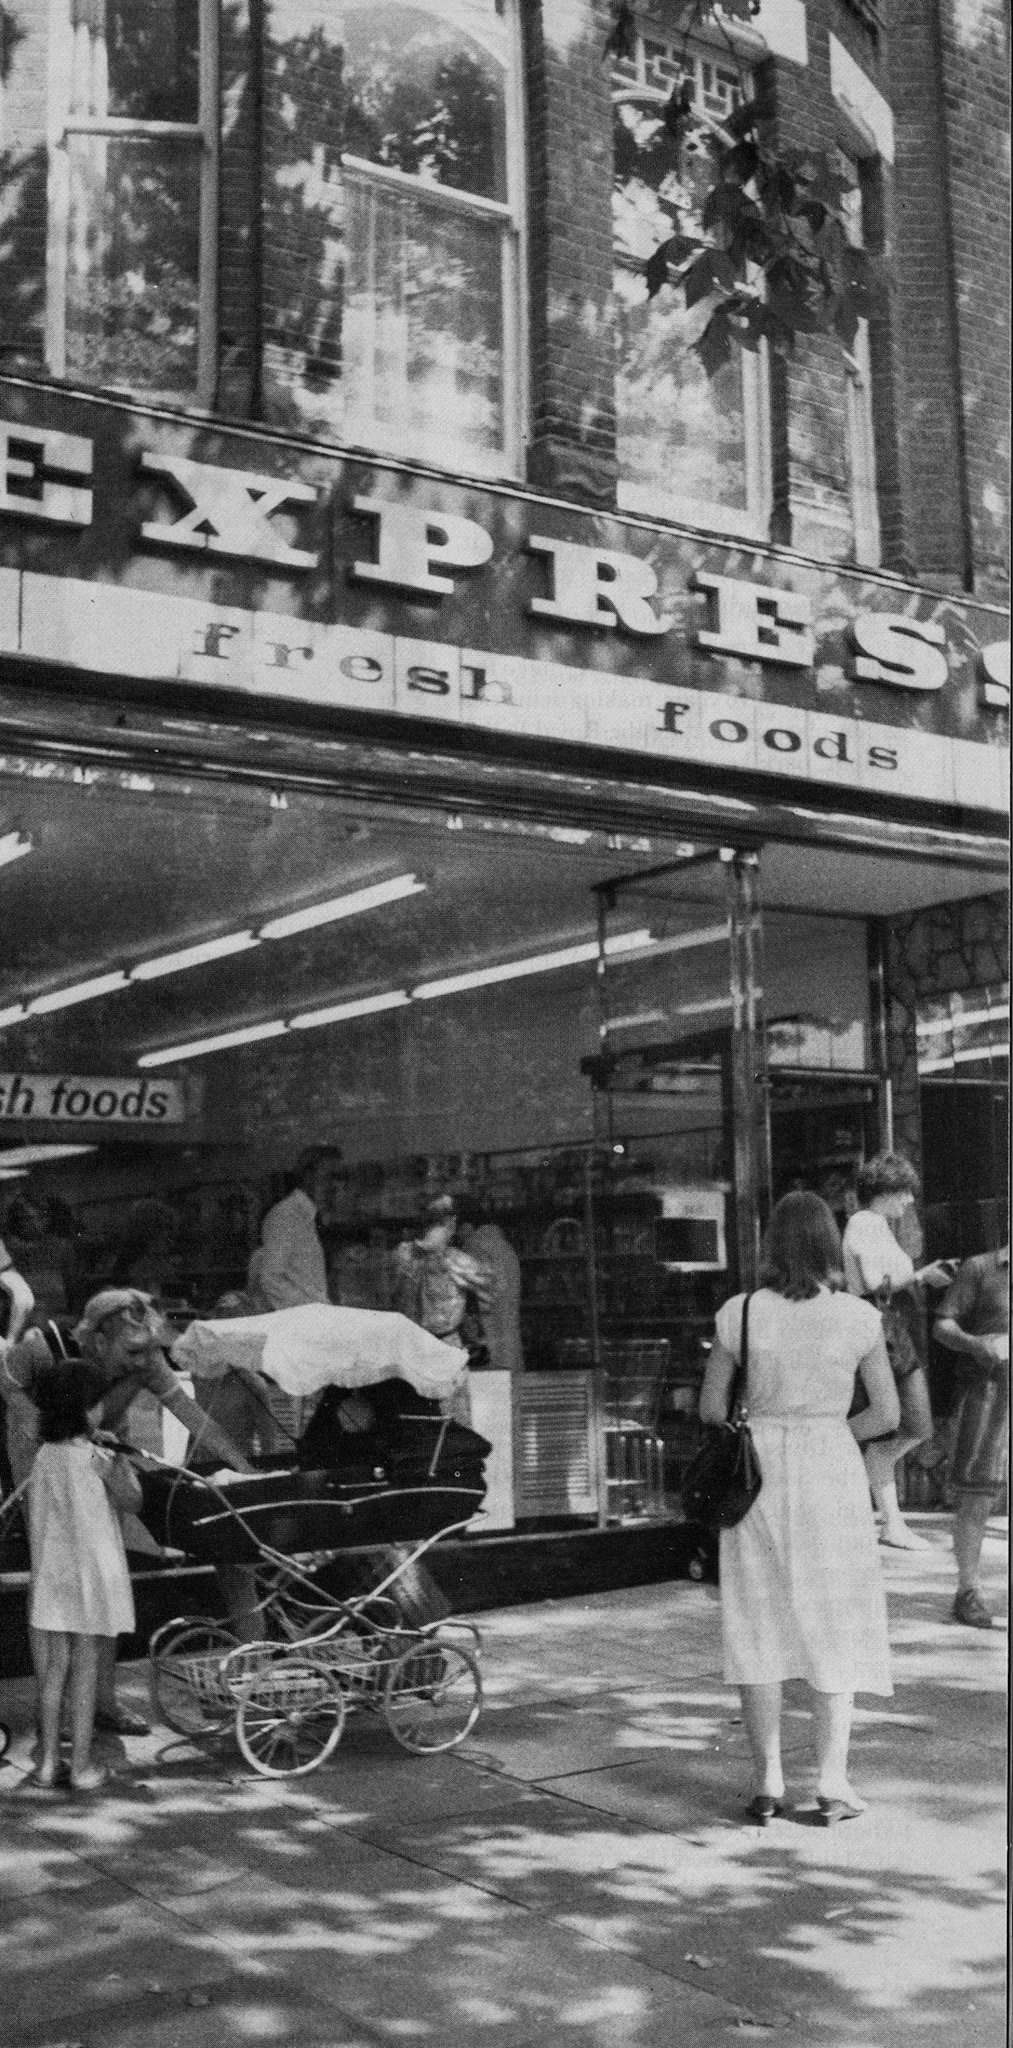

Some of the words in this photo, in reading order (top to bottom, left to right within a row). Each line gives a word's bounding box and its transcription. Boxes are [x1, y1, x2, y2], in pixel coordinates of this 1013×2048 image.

[193, 622, 523, 706] fresh
[655, 701, 898, 771] foods
[50, 1078, 168, 1118] foods
